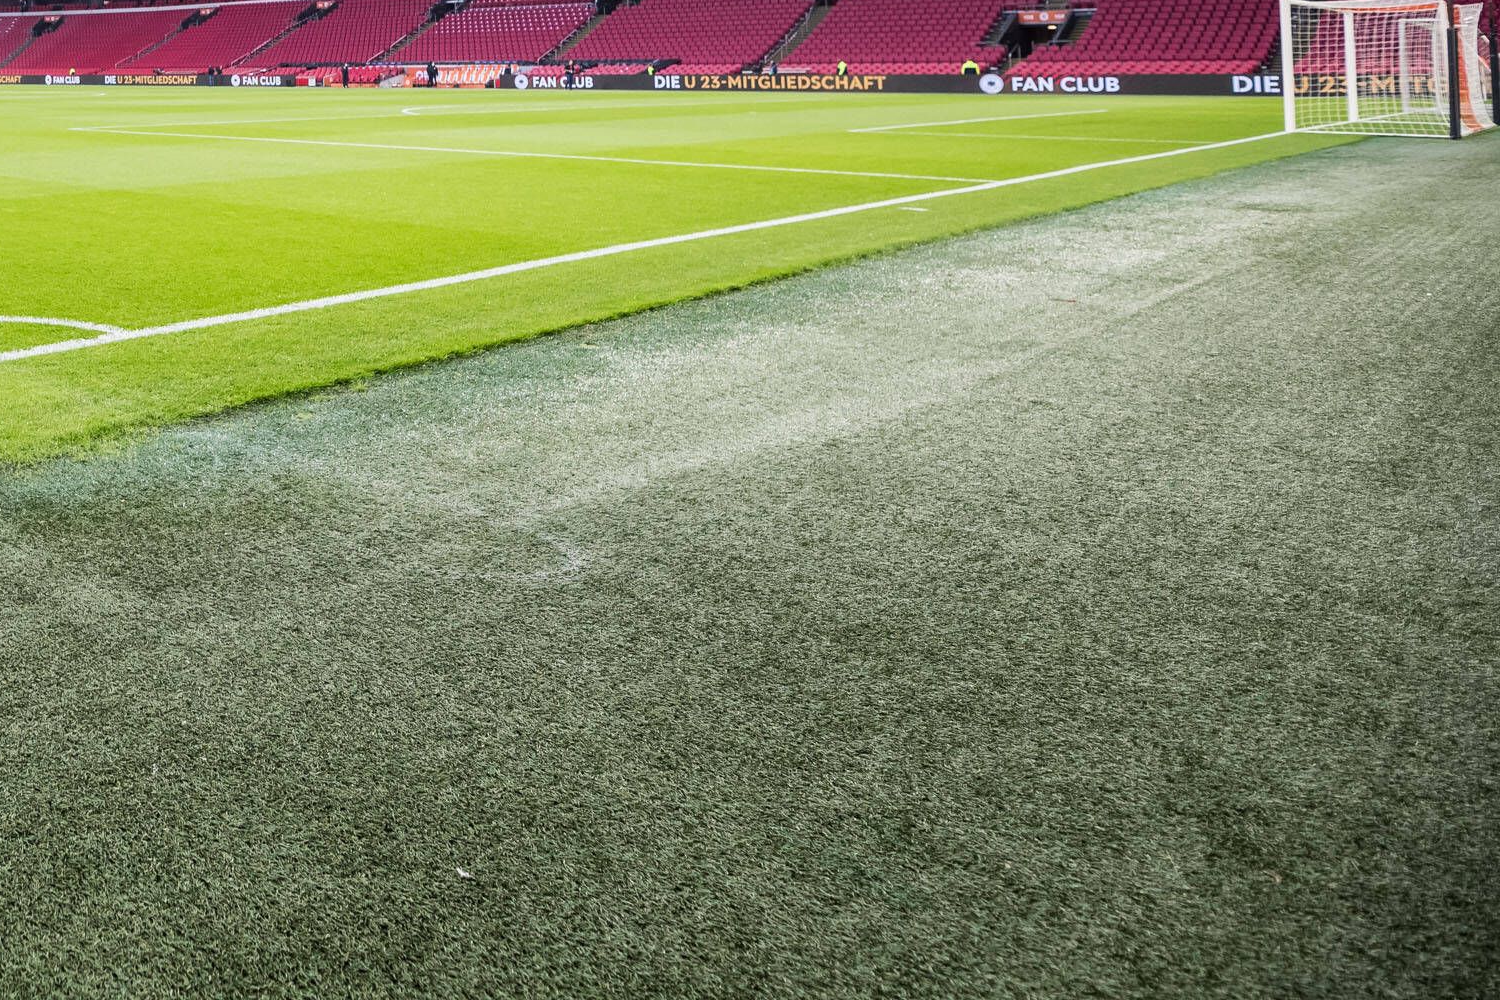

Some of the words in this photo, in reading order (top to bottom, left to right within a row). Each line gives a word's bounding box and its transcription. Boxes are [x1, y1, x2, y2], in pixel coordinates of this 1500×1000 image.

[53, 75, 65, 84] FAN
[65, 75, 81, 85] CLUB
[104, 75, 117, 84] DIE
[117, 75, 123, 84] U
[123, 75, 198, 85] 23-MITGLIEDSCHAFT
[242, 76, 258, 86] FAN
[260, 76, 281, 86] CLUB
[532, 76, 557, 88] FAN
[654, 75, 681, 89] DIE
[684, 75, 696, 89] U
[701, 75, 886, 90] 23-MITGLIEDSCHAFT
[1011, 76, 1054, 92] FAN
[1060, 76, 1120, 92] CLUB
[1232, 75, 1281, 93] DIE
